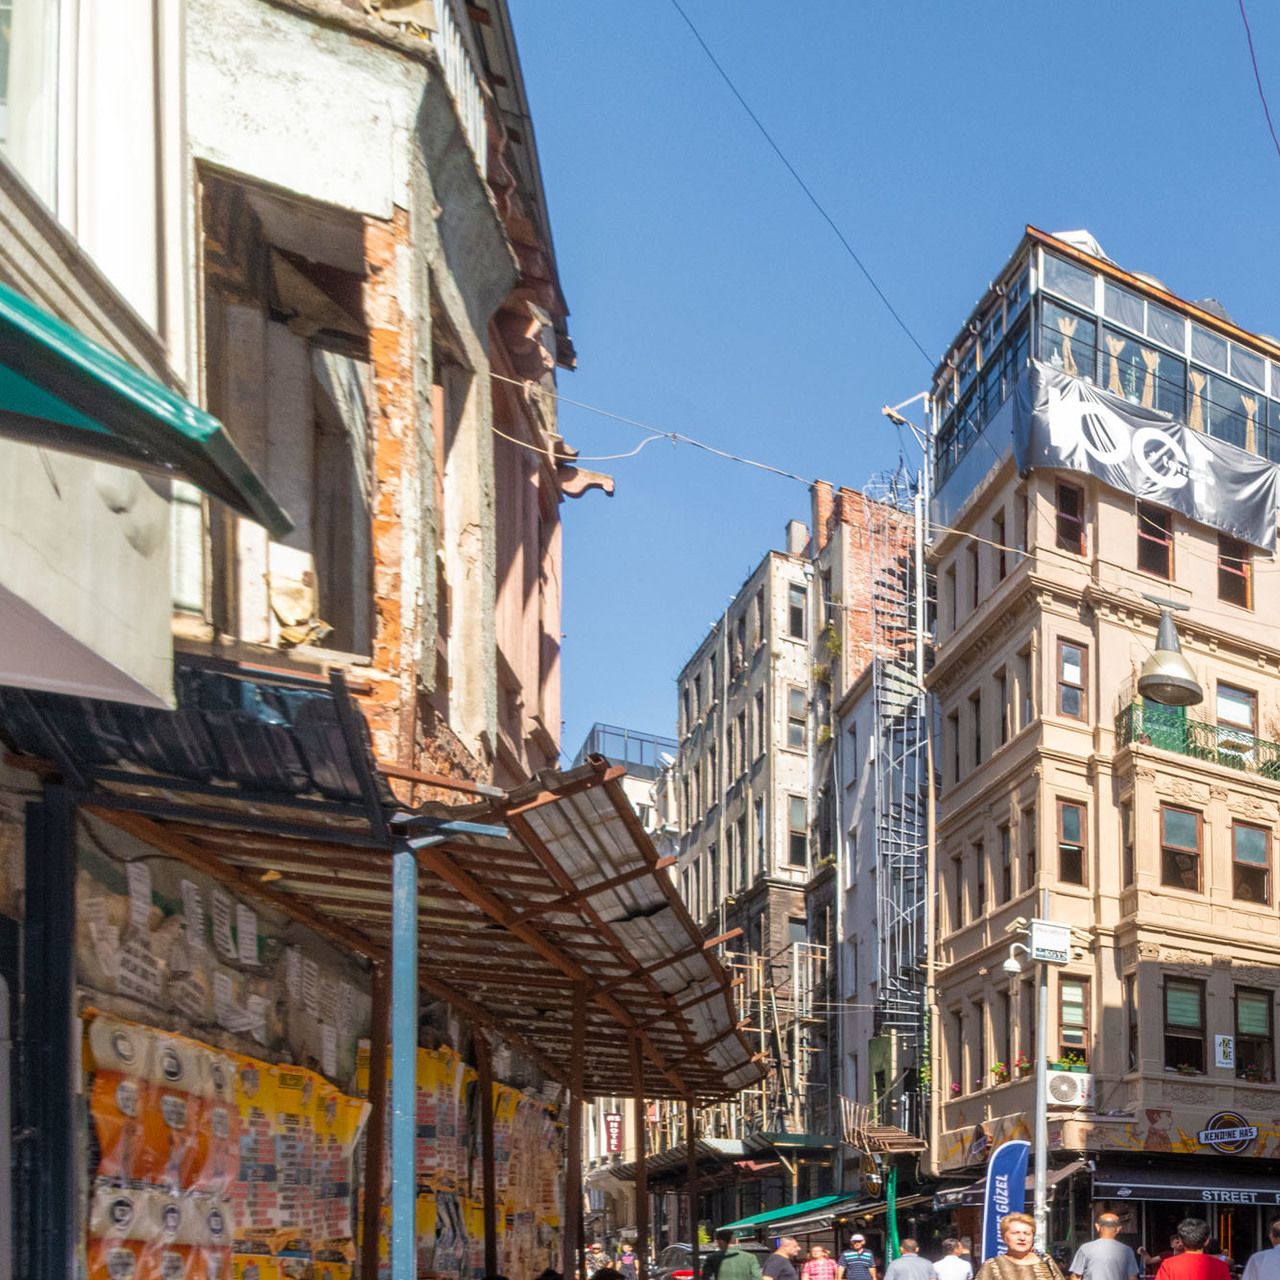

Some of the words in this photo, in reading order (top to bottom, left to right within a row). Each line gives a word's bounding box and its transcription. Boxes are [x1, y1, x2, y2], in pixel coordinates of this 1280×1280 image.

[609, 1122, 619, 1150] HOTEL
[994, 1173, 1009, 1215] GÜZEL
[1202, 1190, 1258, 1203] STREET
